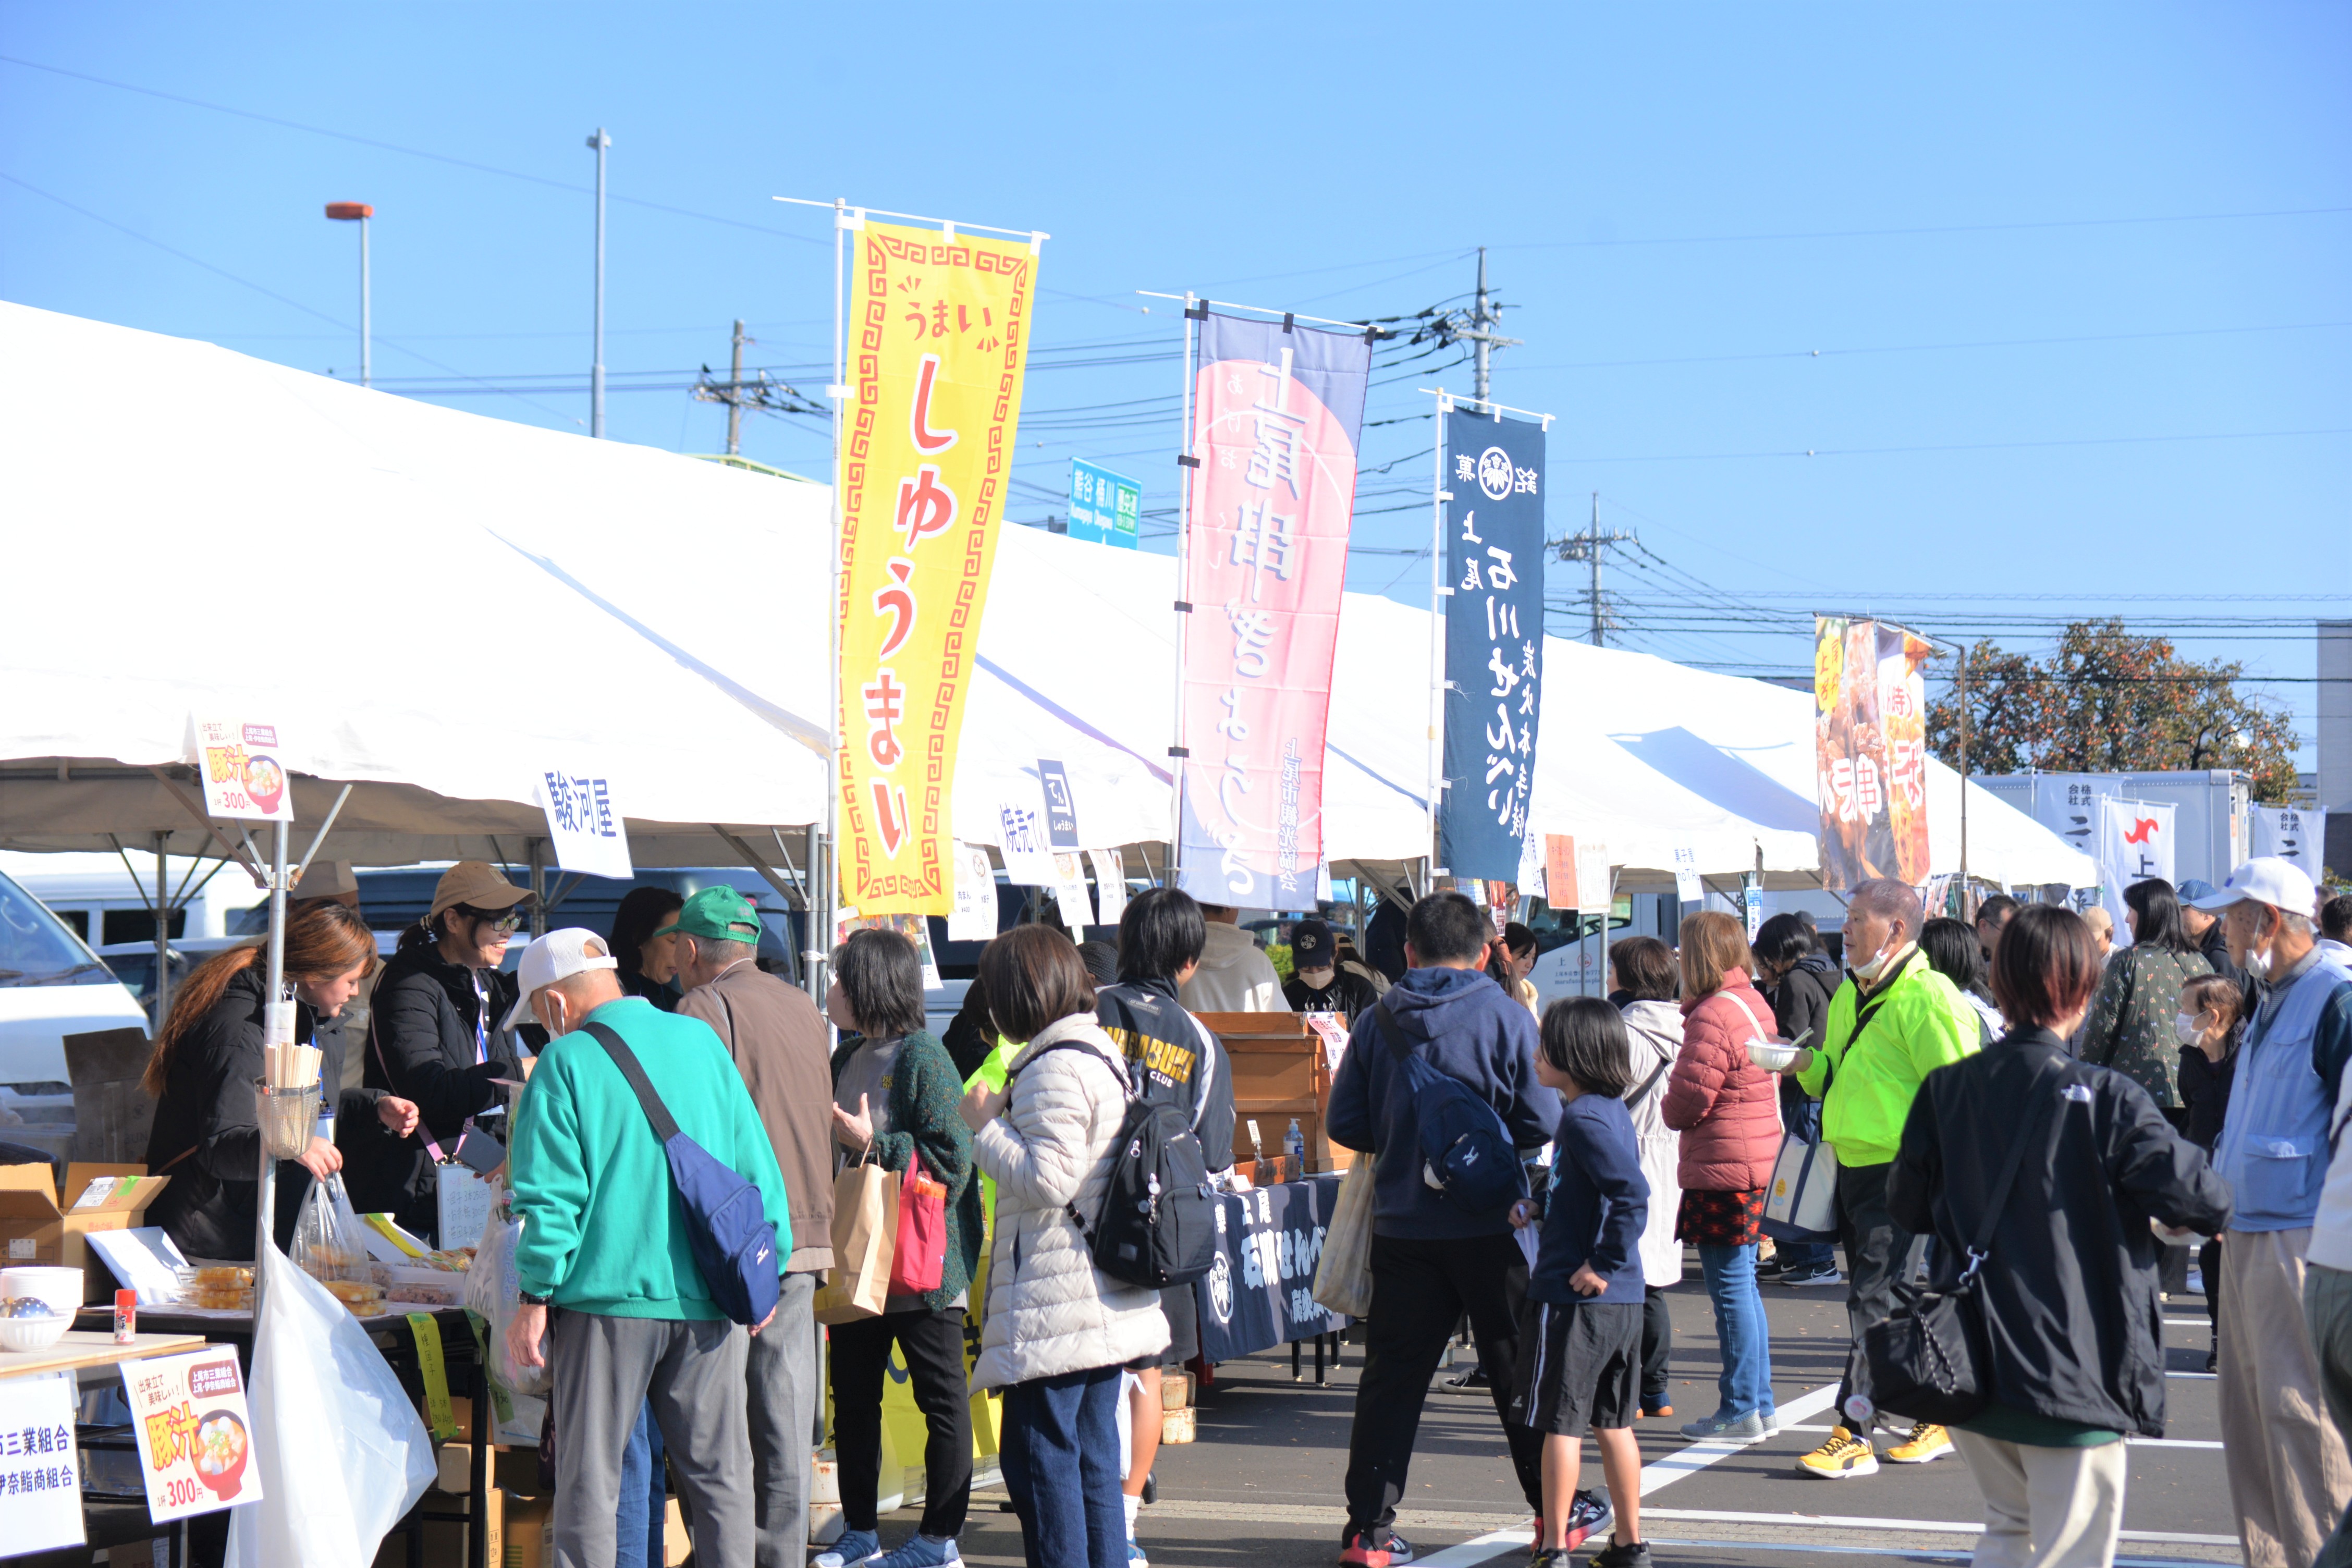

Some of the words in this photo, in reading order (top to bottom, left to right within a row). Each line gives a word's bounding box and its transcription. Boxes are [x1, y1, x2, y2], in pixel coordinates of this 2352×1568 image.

[904, 299, 991, 341] うまい
[862, 354, 958, 859] しゅうまい
[202, 723, 222, 732] 出来立て
[206, 744, 250, 783] 豚汁
[545, 770, 616, 837] 駿河屋
[1048, 782, 1064, 805] てん
[1054, 819, 1073, 832] しゅうまい
[2132, 854, 2155, 878] 上
[958, 891, 971, 900] 肉まん
[1150, 1071, 1173, 1088] CLUB
[138, 1374, 164, 1394] 出来立て
[192, 1365, 233, 1383] 上尾市三業組合
[145, 1400, 201, 1473] 豚汁
